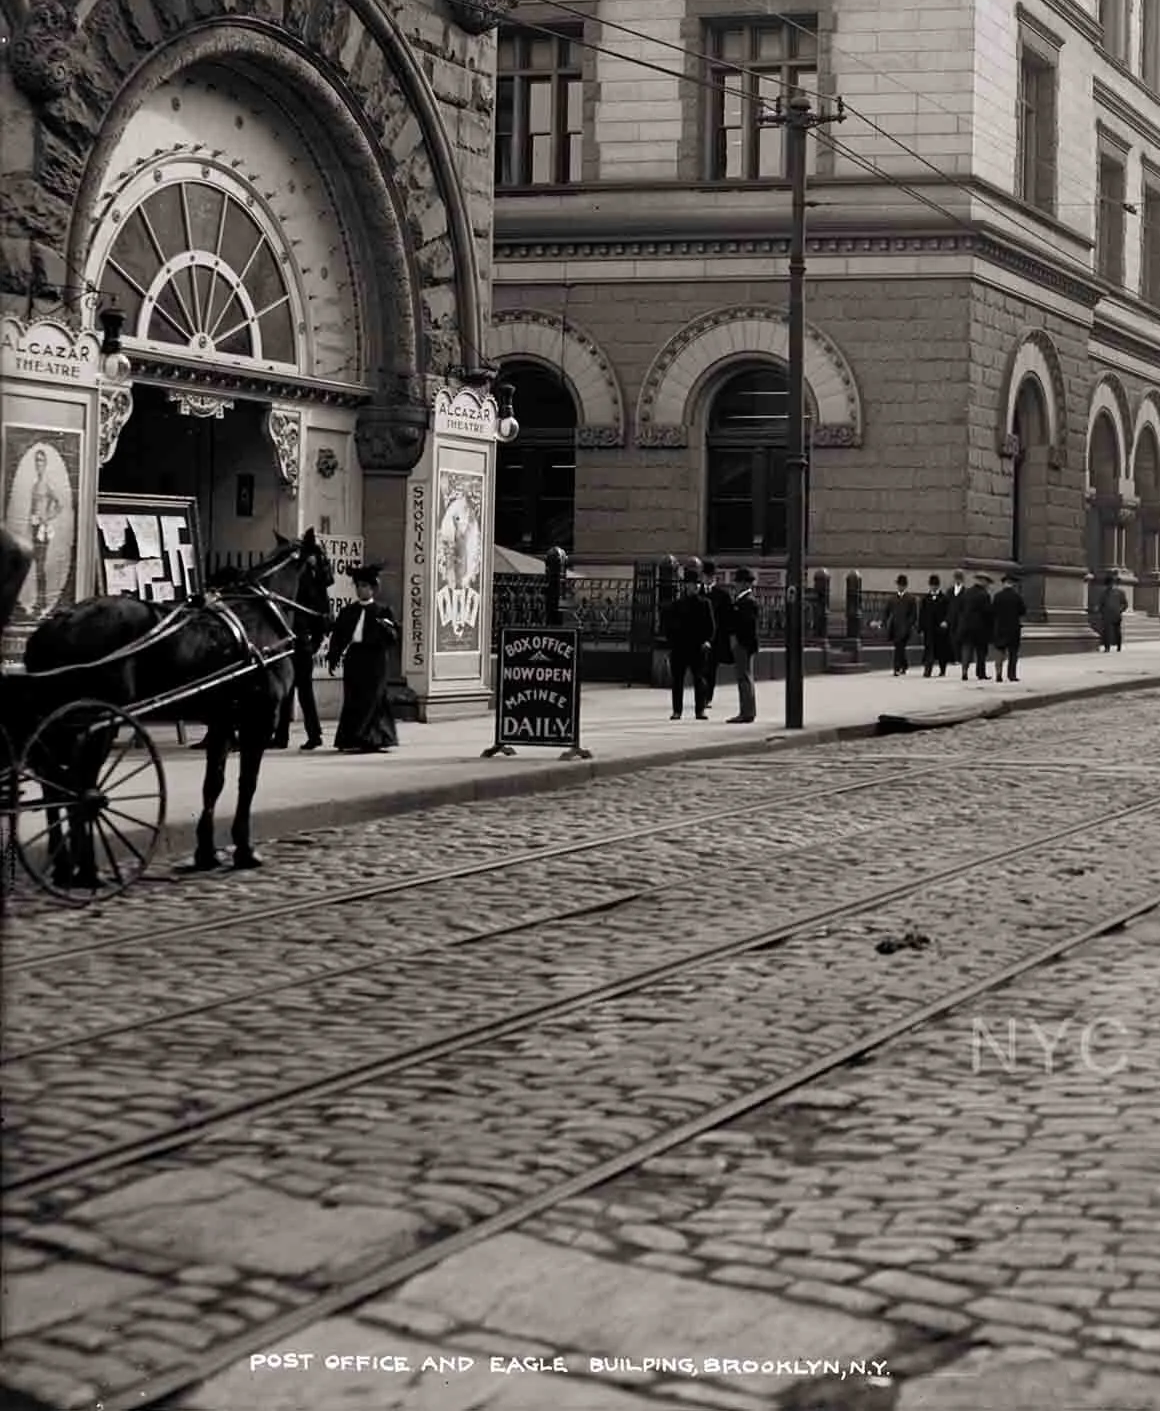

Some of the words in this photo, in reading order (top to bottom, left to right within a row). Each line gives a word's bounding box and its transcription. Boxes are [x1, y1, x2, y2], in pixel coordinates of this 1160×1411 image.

[0, 334, 90, 362] ALCAZAR
[15, 357, 80, 378] THEATRE
[439, 403, 490, 421] ALCAZAR
[413, 487, 425, 565] SMOKING
[410, 573, 425, 666] CONCERTS
[505, 637, 532, 657] BOX
[532, 635, 574, 659] OFFICE
[503, 667, 535, 681] NOW
[535, 667, 572, 682] OPEN
[505, 688, 568, 710] MATINEE
